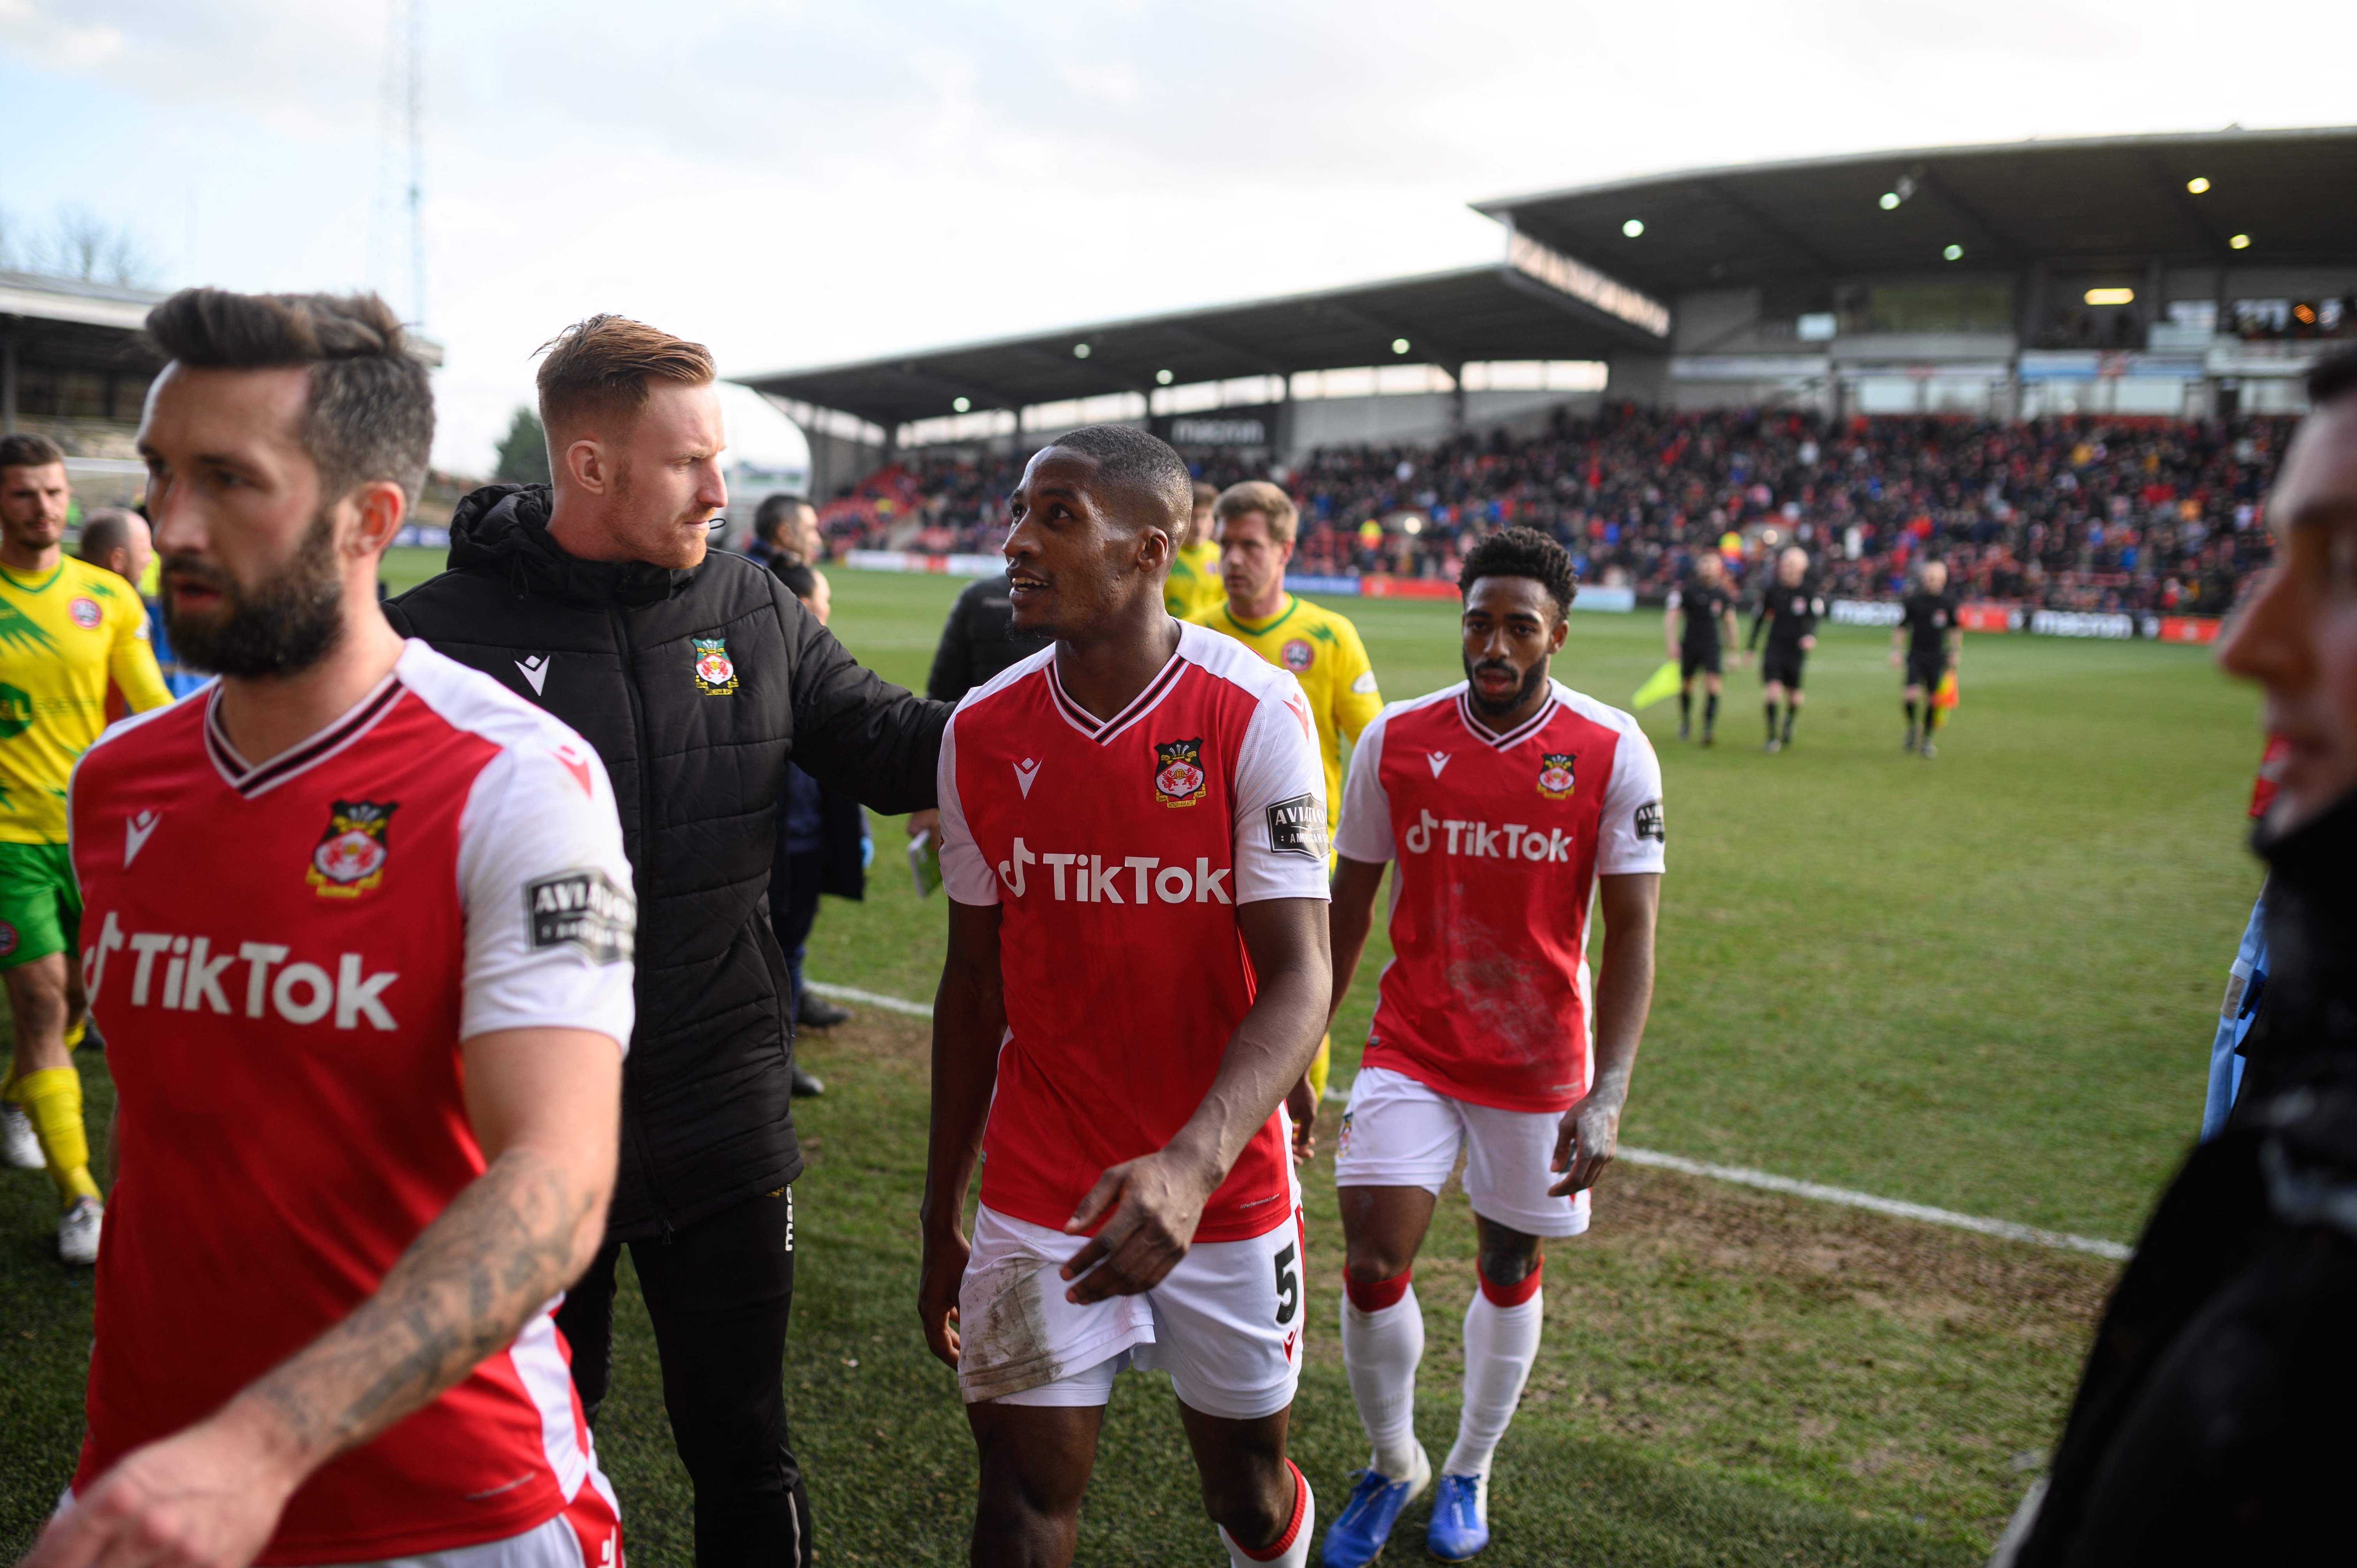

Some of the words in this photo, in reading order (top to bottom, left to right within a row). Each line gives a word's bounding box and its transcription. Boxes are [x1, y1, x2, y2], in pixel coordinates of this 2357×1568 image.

[1276, 806, 1325, 826] AVIATIO
[1442, 819, 1573, 863] TikTok
[1043, 853, 1232, 904] TikTok
[130, 933, 399, 1031] TikTok
[1274, 1240, 1298, 1325] 5
